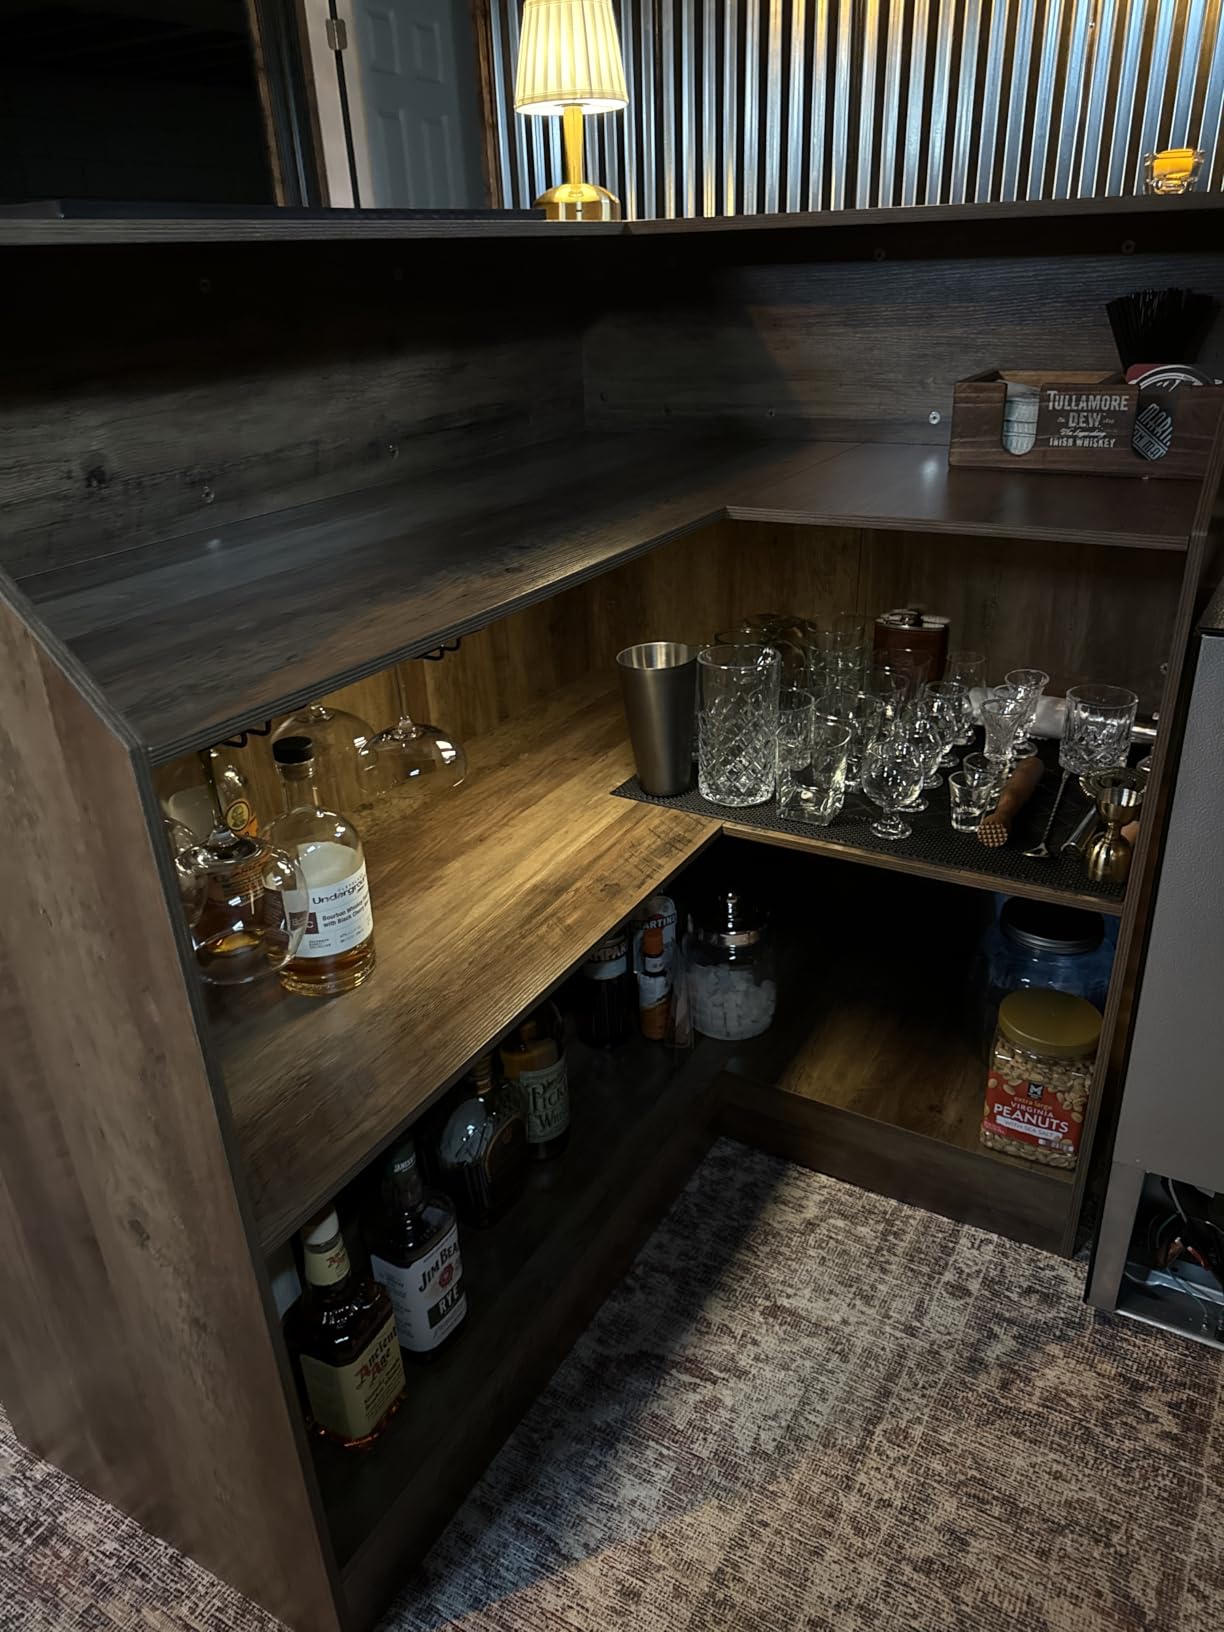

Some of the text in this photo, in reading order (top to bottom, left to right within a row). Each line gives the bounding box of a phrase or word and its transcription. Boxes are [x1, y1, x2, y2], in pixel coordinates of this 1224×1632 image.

[1047, 390, 1130, 411] TULLAMORE
[1049, 437, 1116, 448] IRISH WHISKEY
[322, 909, 346, 921] Bourbon
[323, 919, 337, 927] with
[337, 913, 352, 923] Black
[993, 1103, 1069, 1133] PEANUTS
[1010, 1100, 1055, 1118] VIRGINIA
[1023, 1124, 1037, 1133] SEA
[1037, 1128, 1053, 1138] SALT
[419, 1260, 440, 1292] JIM
[438, 1283, 460, 1315] RYE
